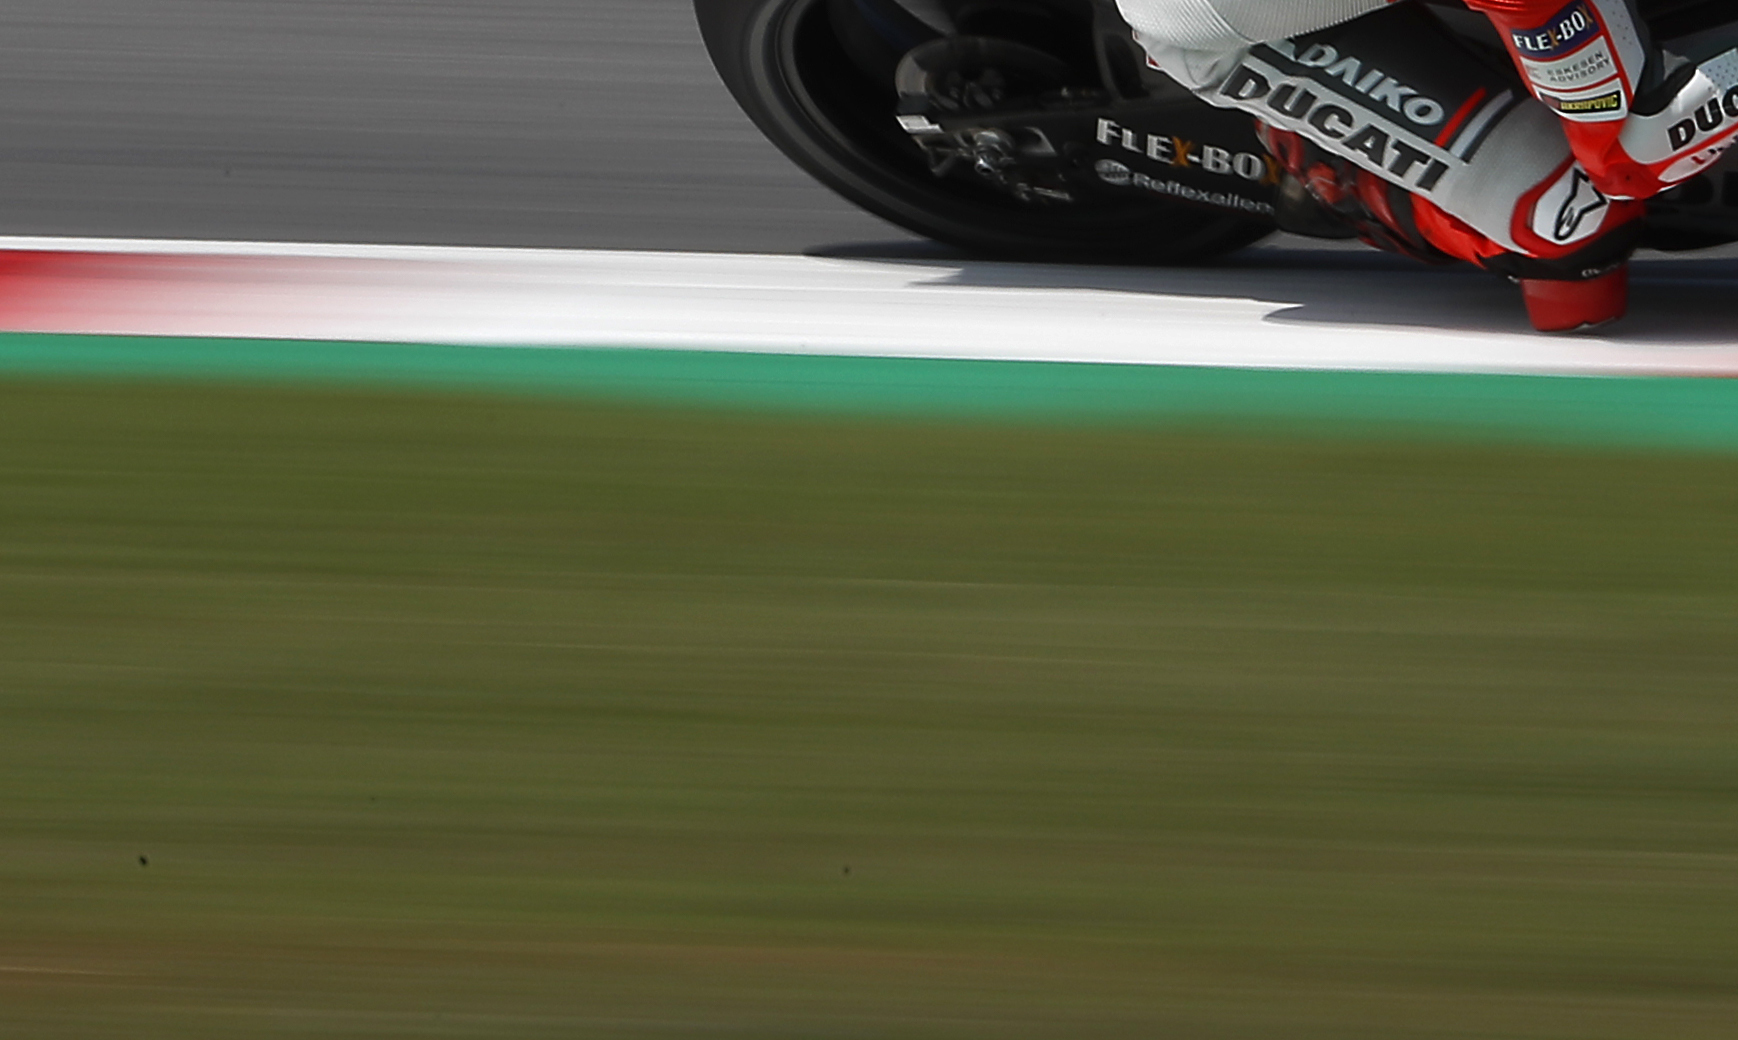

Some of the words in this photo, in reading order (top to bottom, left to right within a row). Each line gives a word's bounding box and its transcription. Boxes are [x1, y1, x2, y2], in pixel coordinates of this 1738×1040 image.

[1512, 3, 1594, 52] FLEX-BOX
[1297, 42, 1446, 127] DAIKO
[1546, 50, 1604, 77] ESKESEN
[1549, 55, 1614, 84] ADVISORY
[1096, 117, 1283, 184] FLEX-BOX
[1220, 64, 1450, 192] DUCATI
